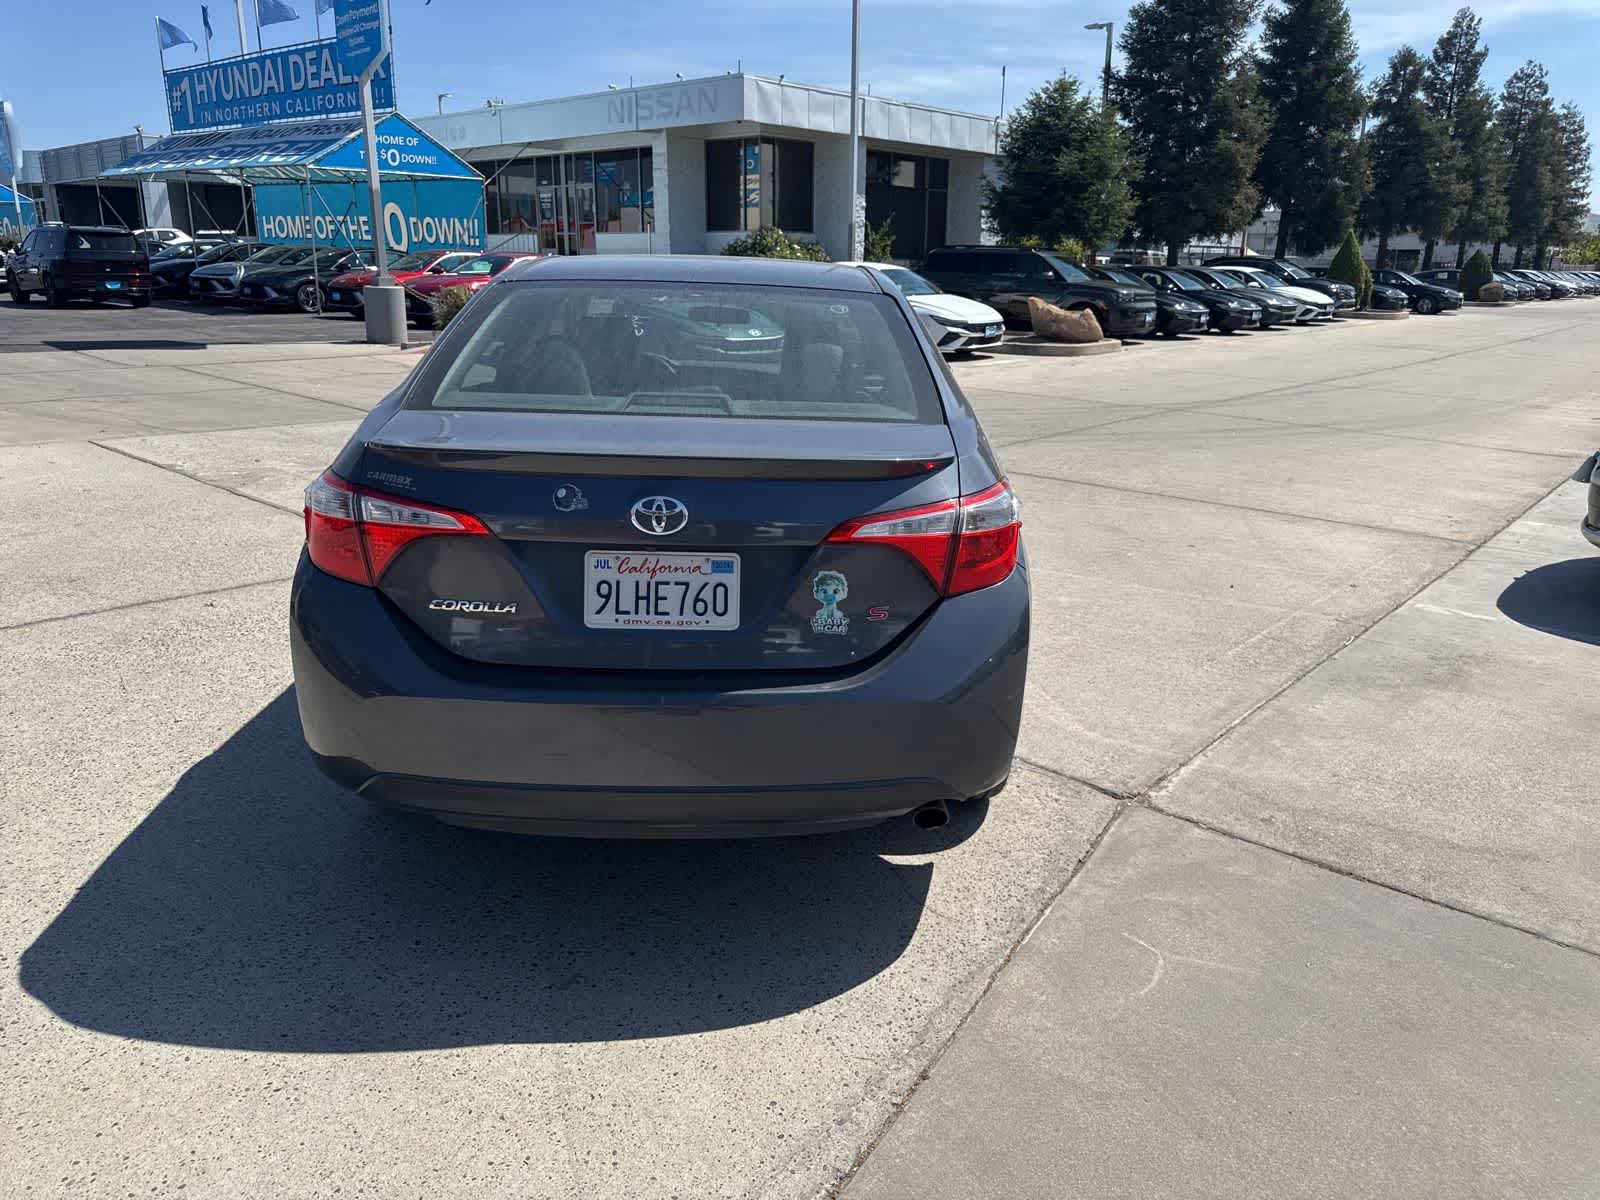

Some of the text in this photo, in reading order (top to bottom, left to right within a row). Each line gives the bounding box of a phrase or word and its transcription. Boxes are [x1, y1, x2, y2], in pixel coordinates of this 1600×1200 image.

[172, 47, 387, 125] #1 HYUNDAI DEAL
[200, 86, 385, 124] IN NORTHERN CALIFORN!!
[607, 87, 718, 124] NISSAN
[375, 134, 419, 146] HOME OF
[380, 148, 400, 167] $0
[401, 153, 437, 165] DOWN!!
[263, 215, 313, 240] HOME
[314, 215, 335, 239] OF
[336, 215, 372, 241] THE
[408, 215, 480, 247] DOWN!!
[593, 559, 612, 570] JUL
[617, 556, 712, 580] California
[429, 599, 518, 614] COROLLA
[594, 579, 729, 617] 9LHE760
[623, 617, 702, 626] dmv.ca.gov
[817, 617, 848, 627] BABY
[866, 605, 890, 622] S
[815, 624, 846, 634] IN CAR
